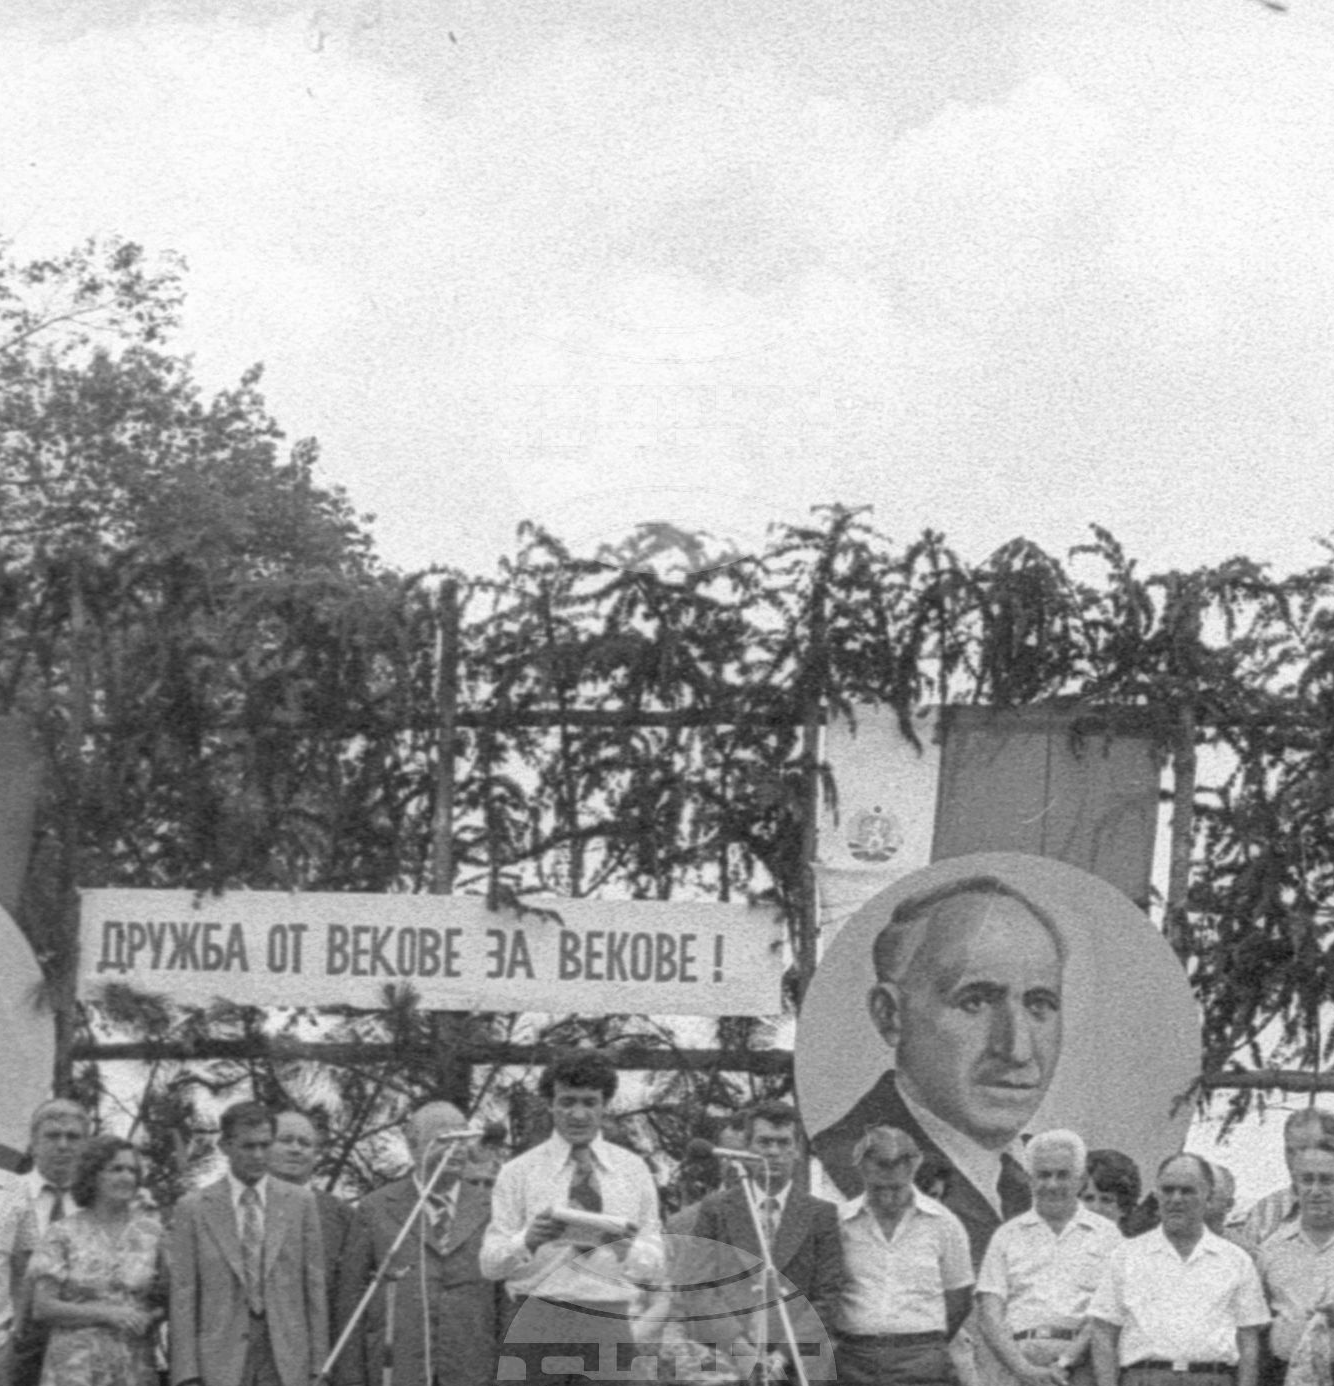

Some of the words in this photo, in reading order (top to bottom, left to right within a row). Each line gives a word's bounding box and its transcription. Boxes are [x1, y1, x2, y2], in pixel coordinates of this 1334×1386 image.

[97, 920, 250, 974] ДРУЖБА
[267, 922, 309, 974] ОТ
[325, 922, 463, 978] ВЕКОВЕ
[485, 928, 535, 979] ЗА
